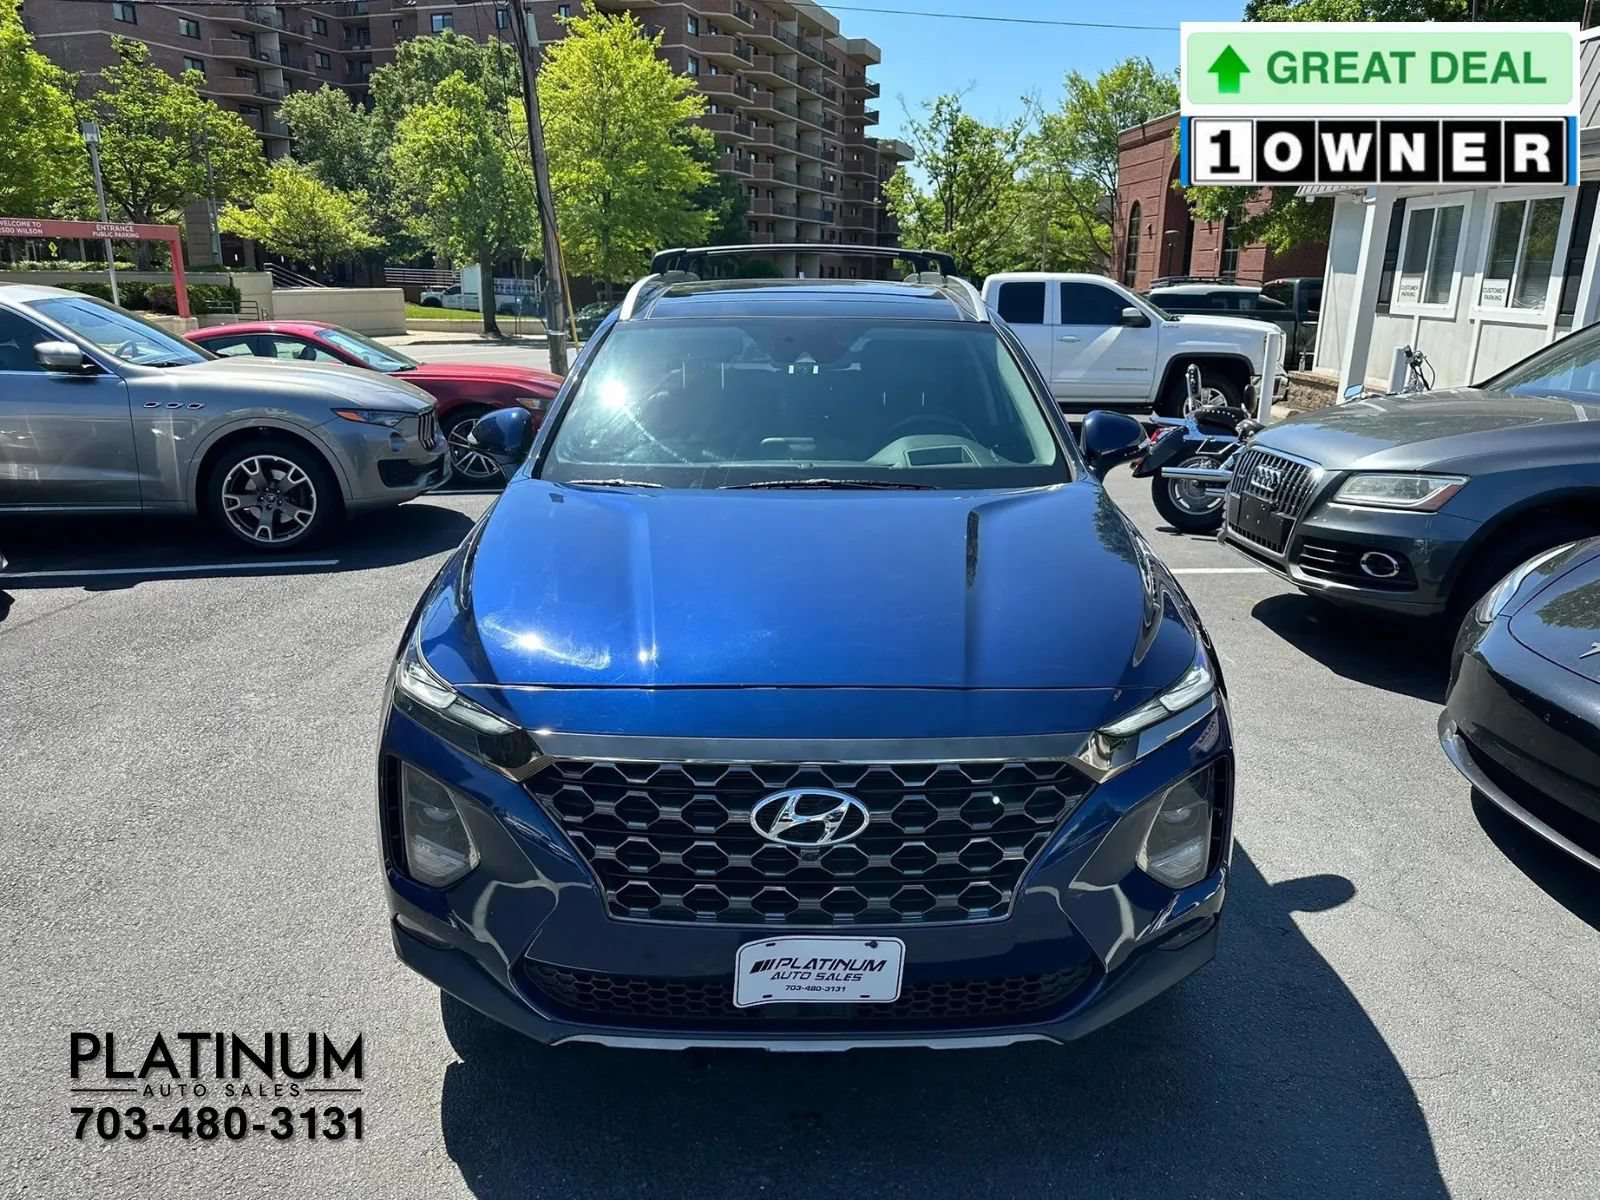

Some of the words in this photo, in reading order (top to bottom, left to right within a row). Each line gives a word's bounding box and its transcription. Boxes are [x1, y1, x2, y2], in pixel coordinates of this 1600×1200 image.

[96, 224, 134, 232] ENTRANCE
[775, 957, 888, 972] PLATINUM
[769, 971, 812, 980] AUTO
[814, 972, 864, 982] SALES
[785, 984, 846, 992] 703-480-3131
